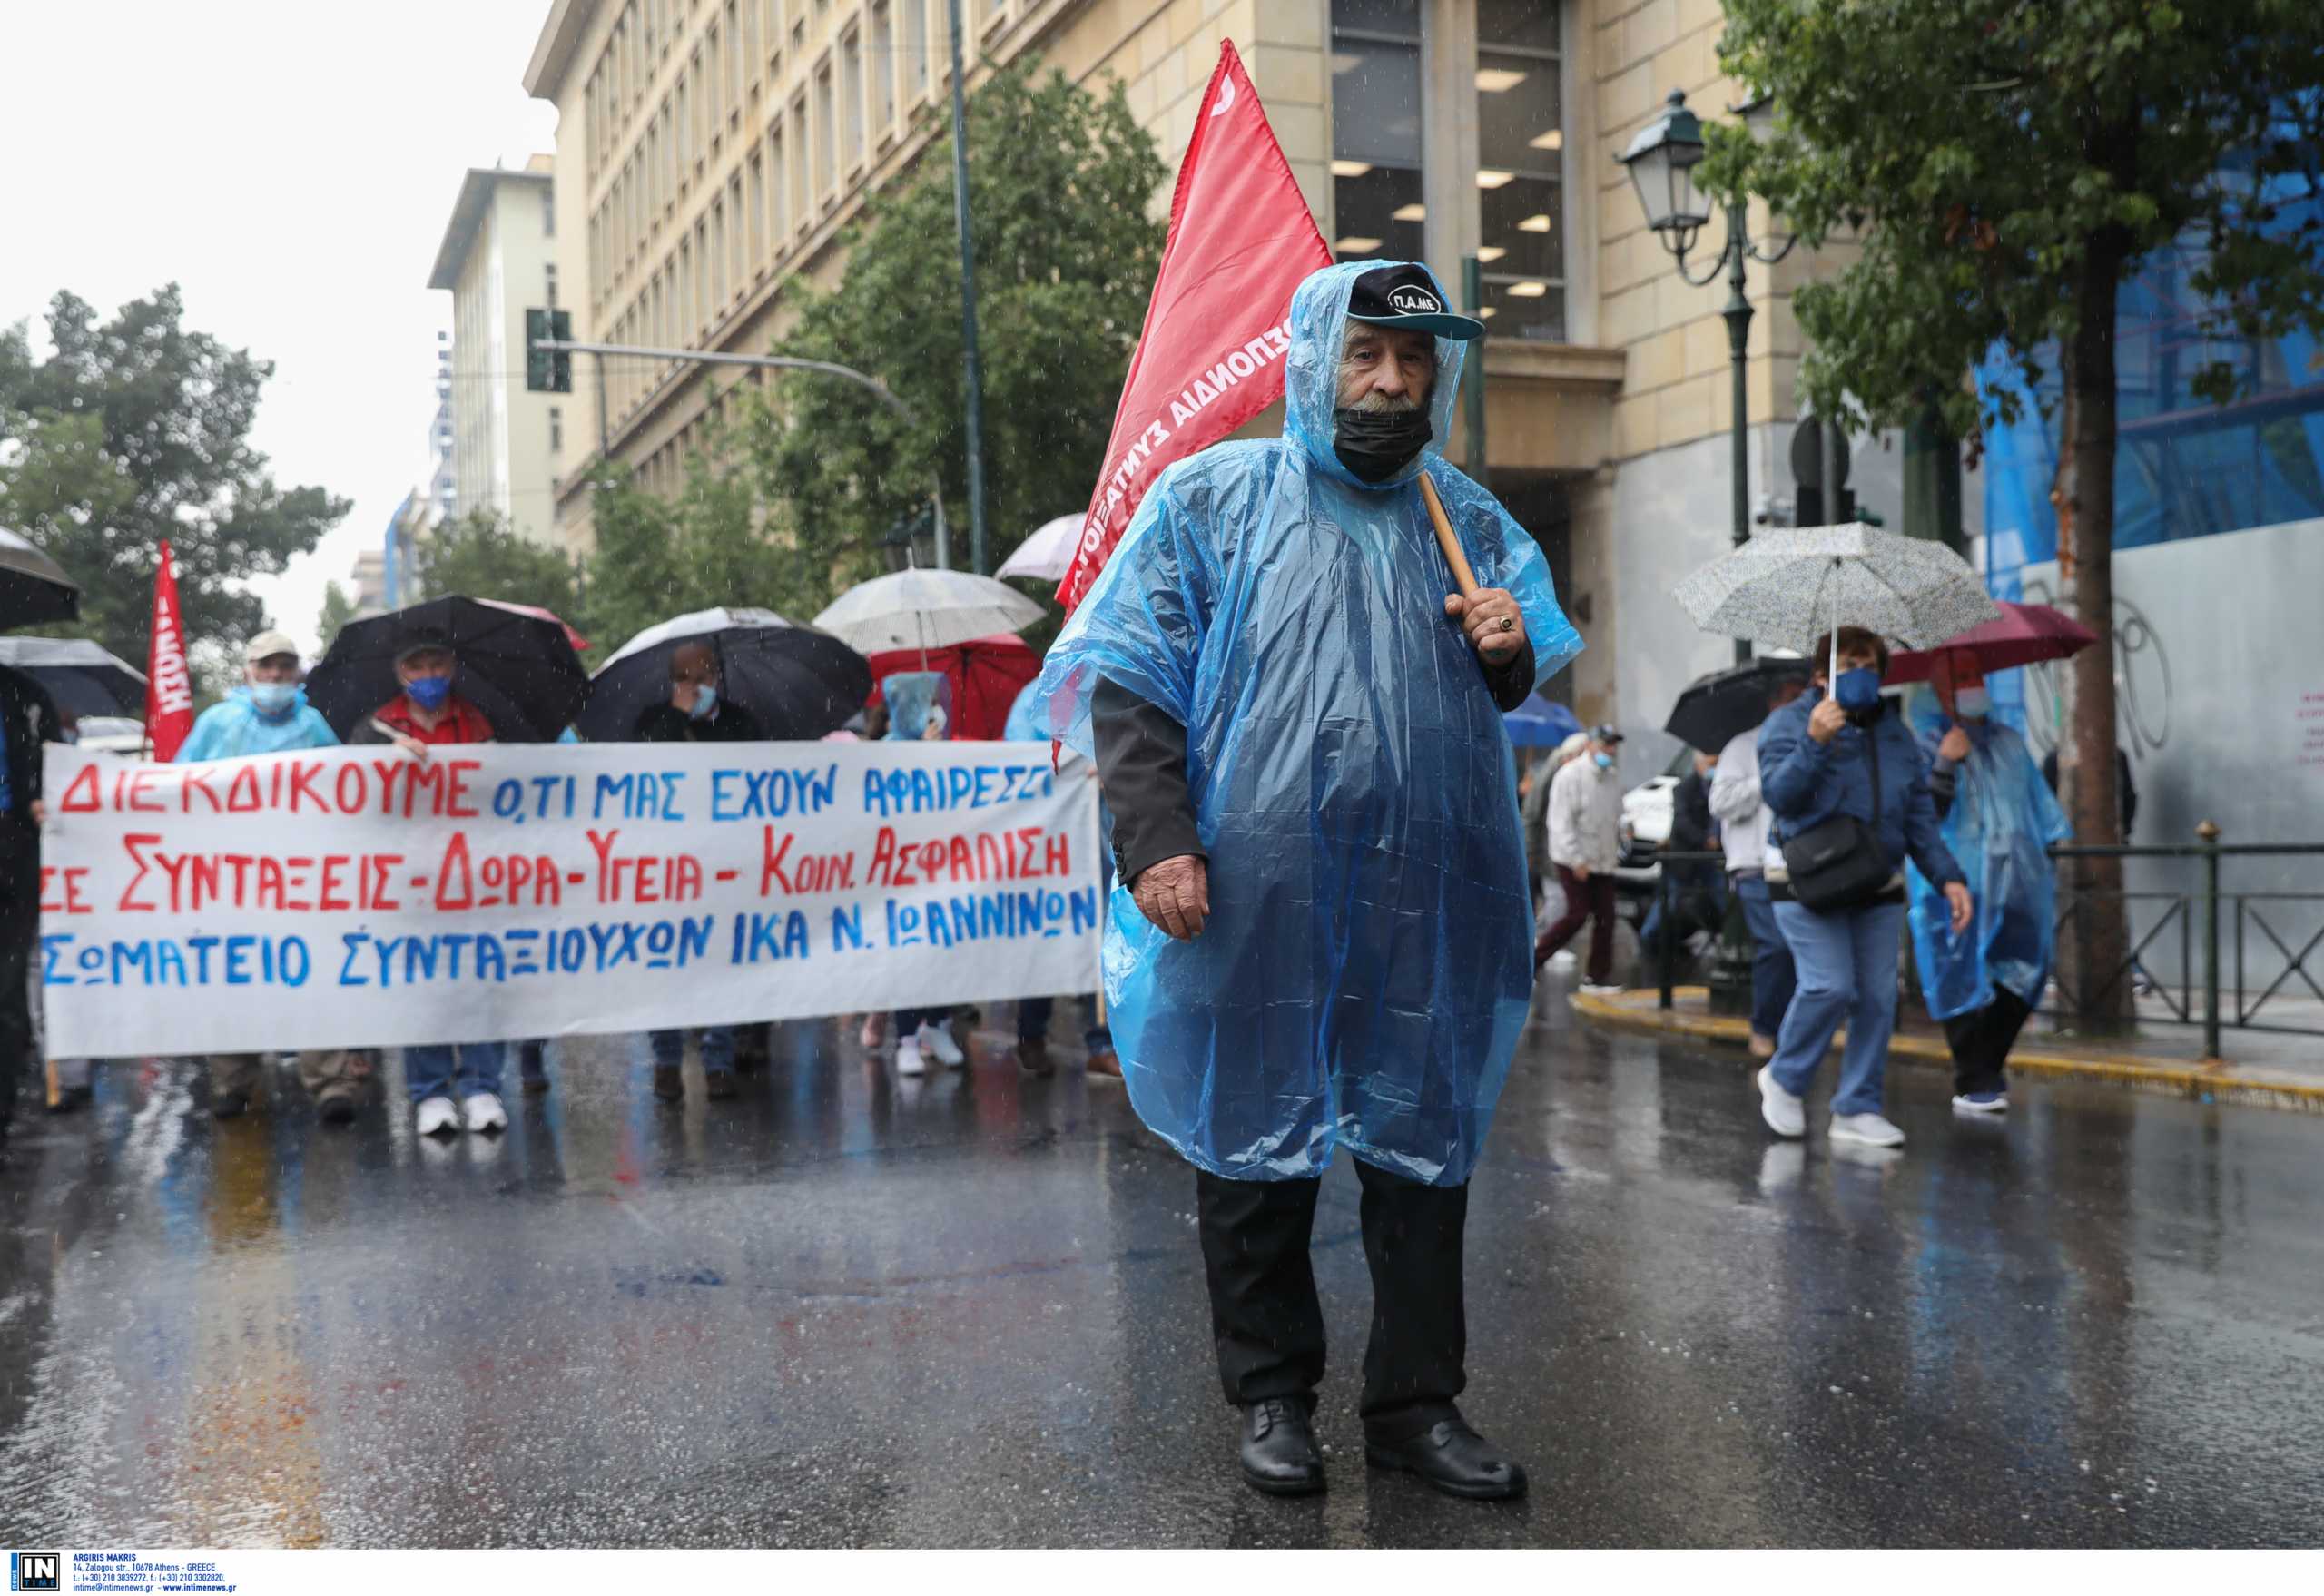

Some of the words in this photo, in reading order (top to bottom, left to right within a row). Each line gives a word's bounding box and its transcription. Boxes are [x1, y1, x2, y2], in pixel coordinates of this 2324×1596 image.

[60, 760, 481, 818] ΔΙΕΚΔΙΚΟΥΜΕ
[594, 772, 686, 820] ΜΑΣ
[712, 764, 837, 820] ΕΧΟΥΝ
[41, 933, 310, 987] ΣΩΜΑΤΕΙΟ
[339, 915, 714, 987] ΣΥΝΤΑΞΙΟΥΧΩΝ
[731, 912, 808, 964] ΙΚΑ
[886, 886, 1097, 948] ΙΩΑΝΝΙΝΩΝ
